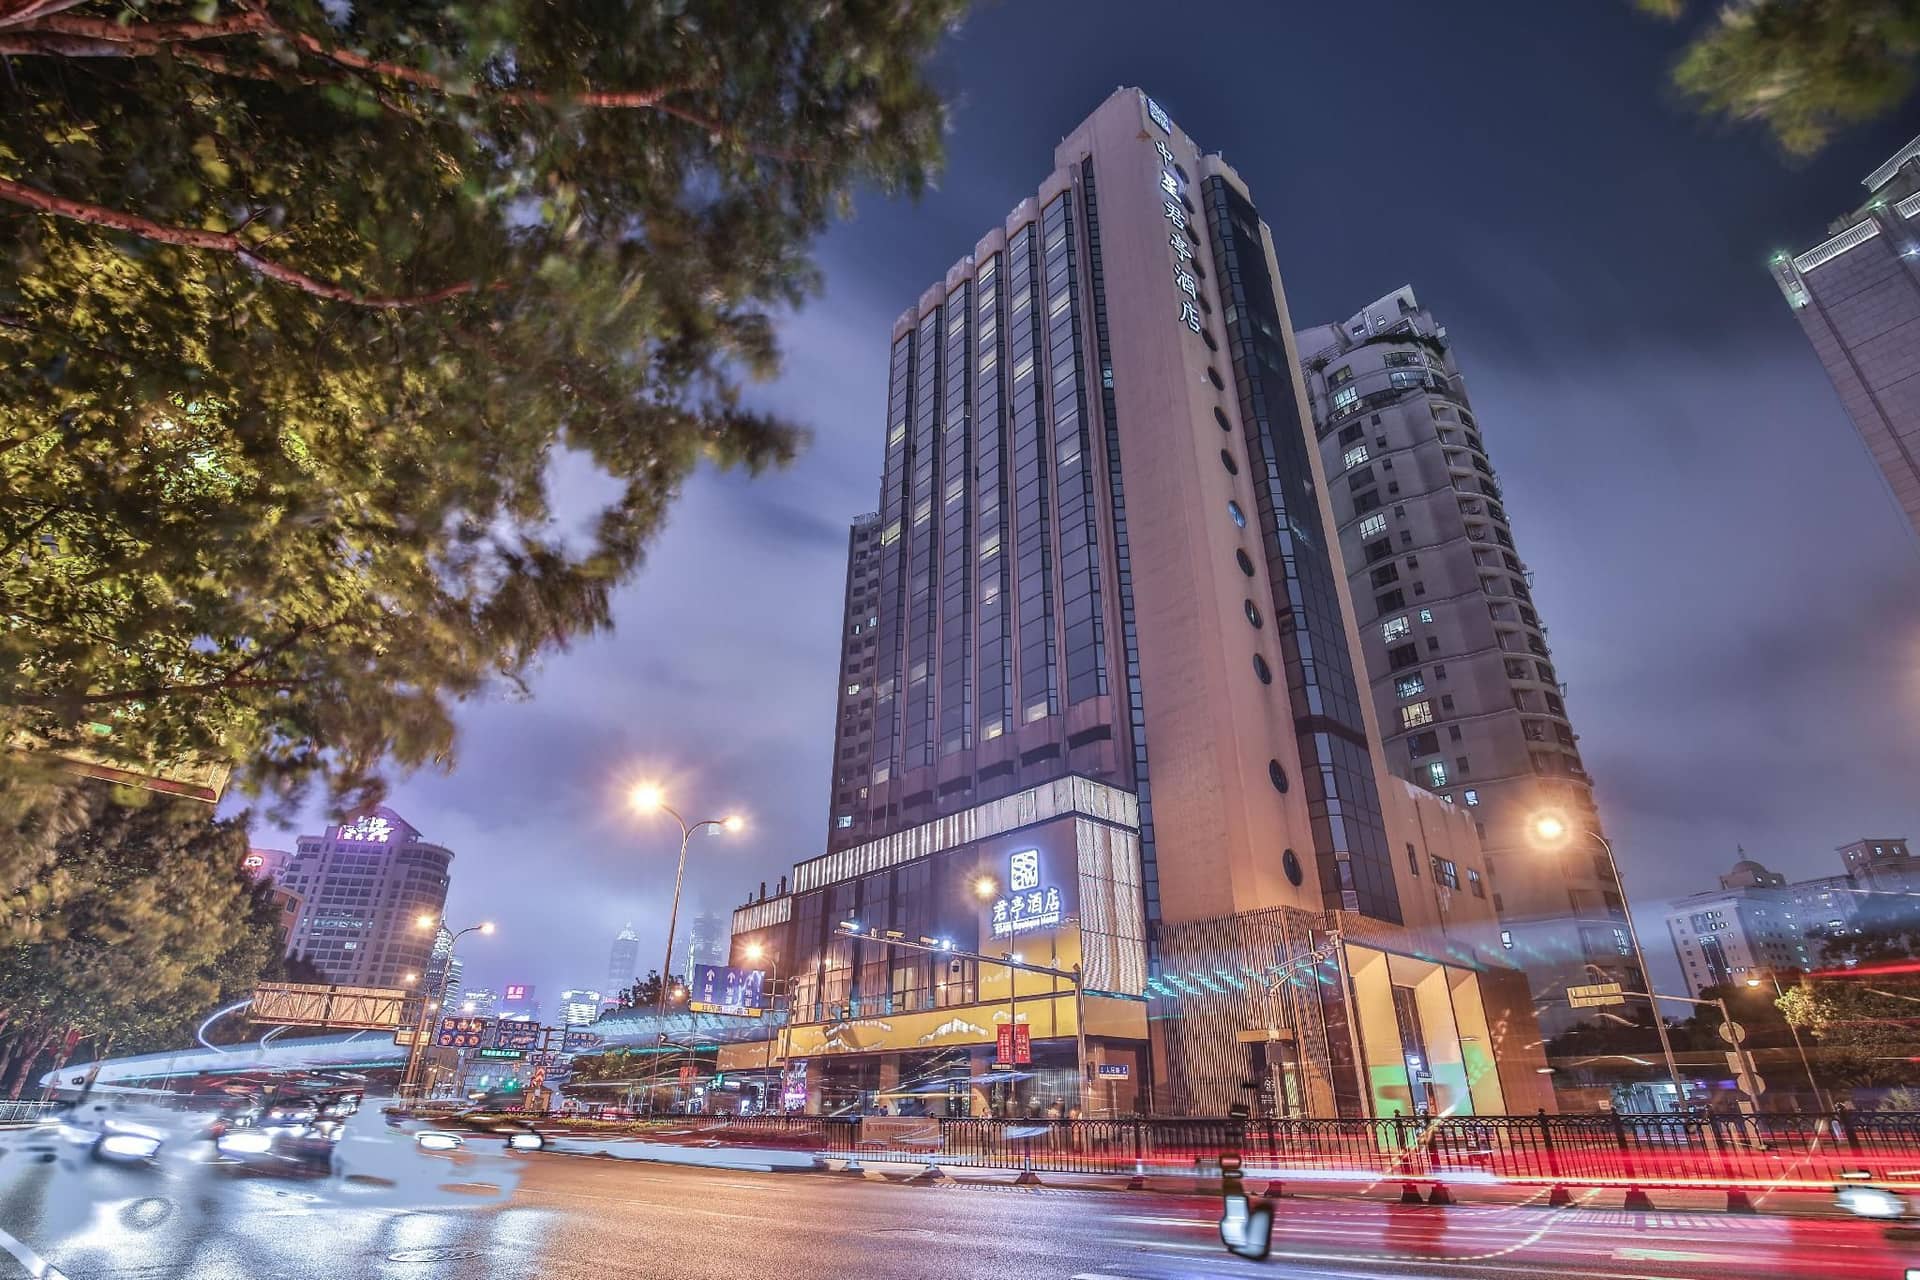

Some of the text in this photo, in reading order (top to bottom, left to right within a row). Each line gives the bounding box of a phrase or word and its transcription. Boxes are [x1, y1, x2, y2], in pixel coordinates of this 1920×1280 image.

[1154, 140, 1200, 333] 中星君亭酒店
[993, 887, 1060, 922] 君亭酒店
